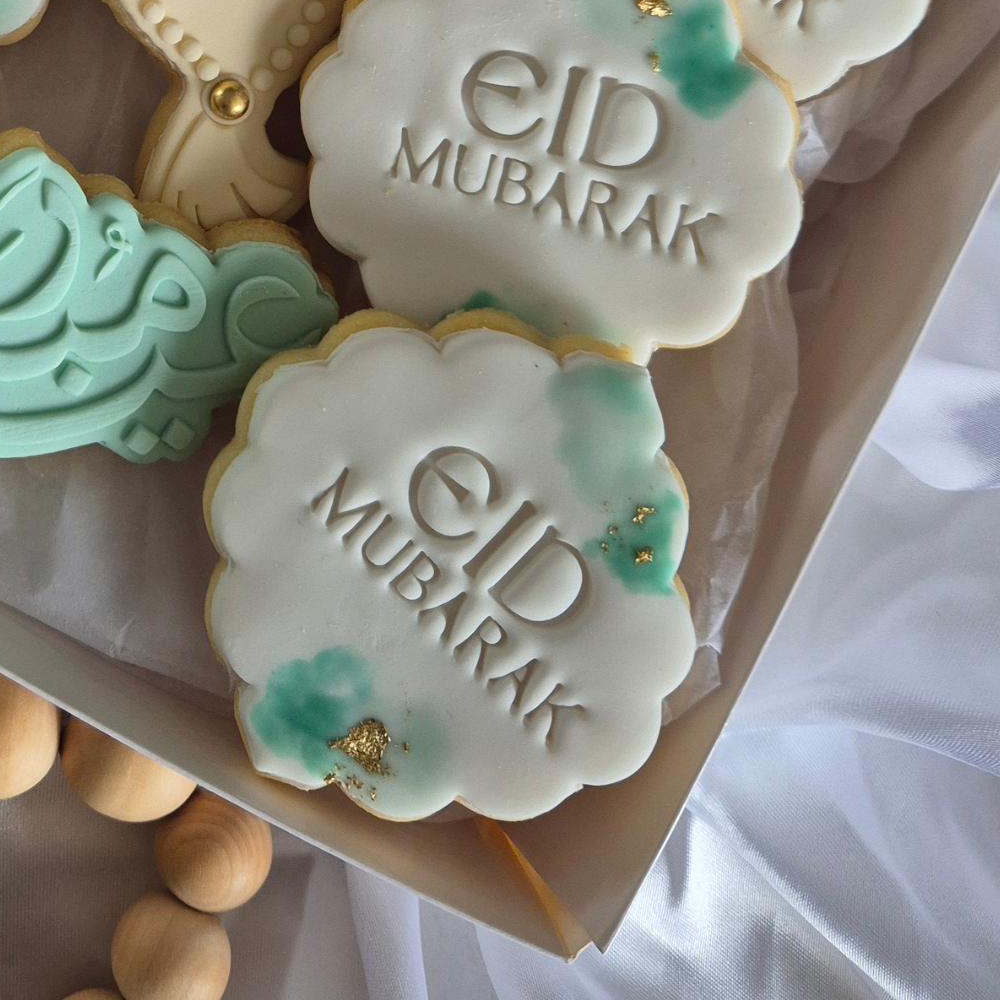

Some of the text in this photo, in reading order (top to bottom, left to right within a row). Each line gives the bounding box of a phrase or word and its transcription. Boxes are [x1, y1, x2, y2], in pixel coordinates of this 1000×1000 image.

[460, 49, 665, 170] EID
[390, 126, 720, 264] MUBARAK
[309, 466, 586, 750] MUBARAK
[407, 445, 587, 624] EID
